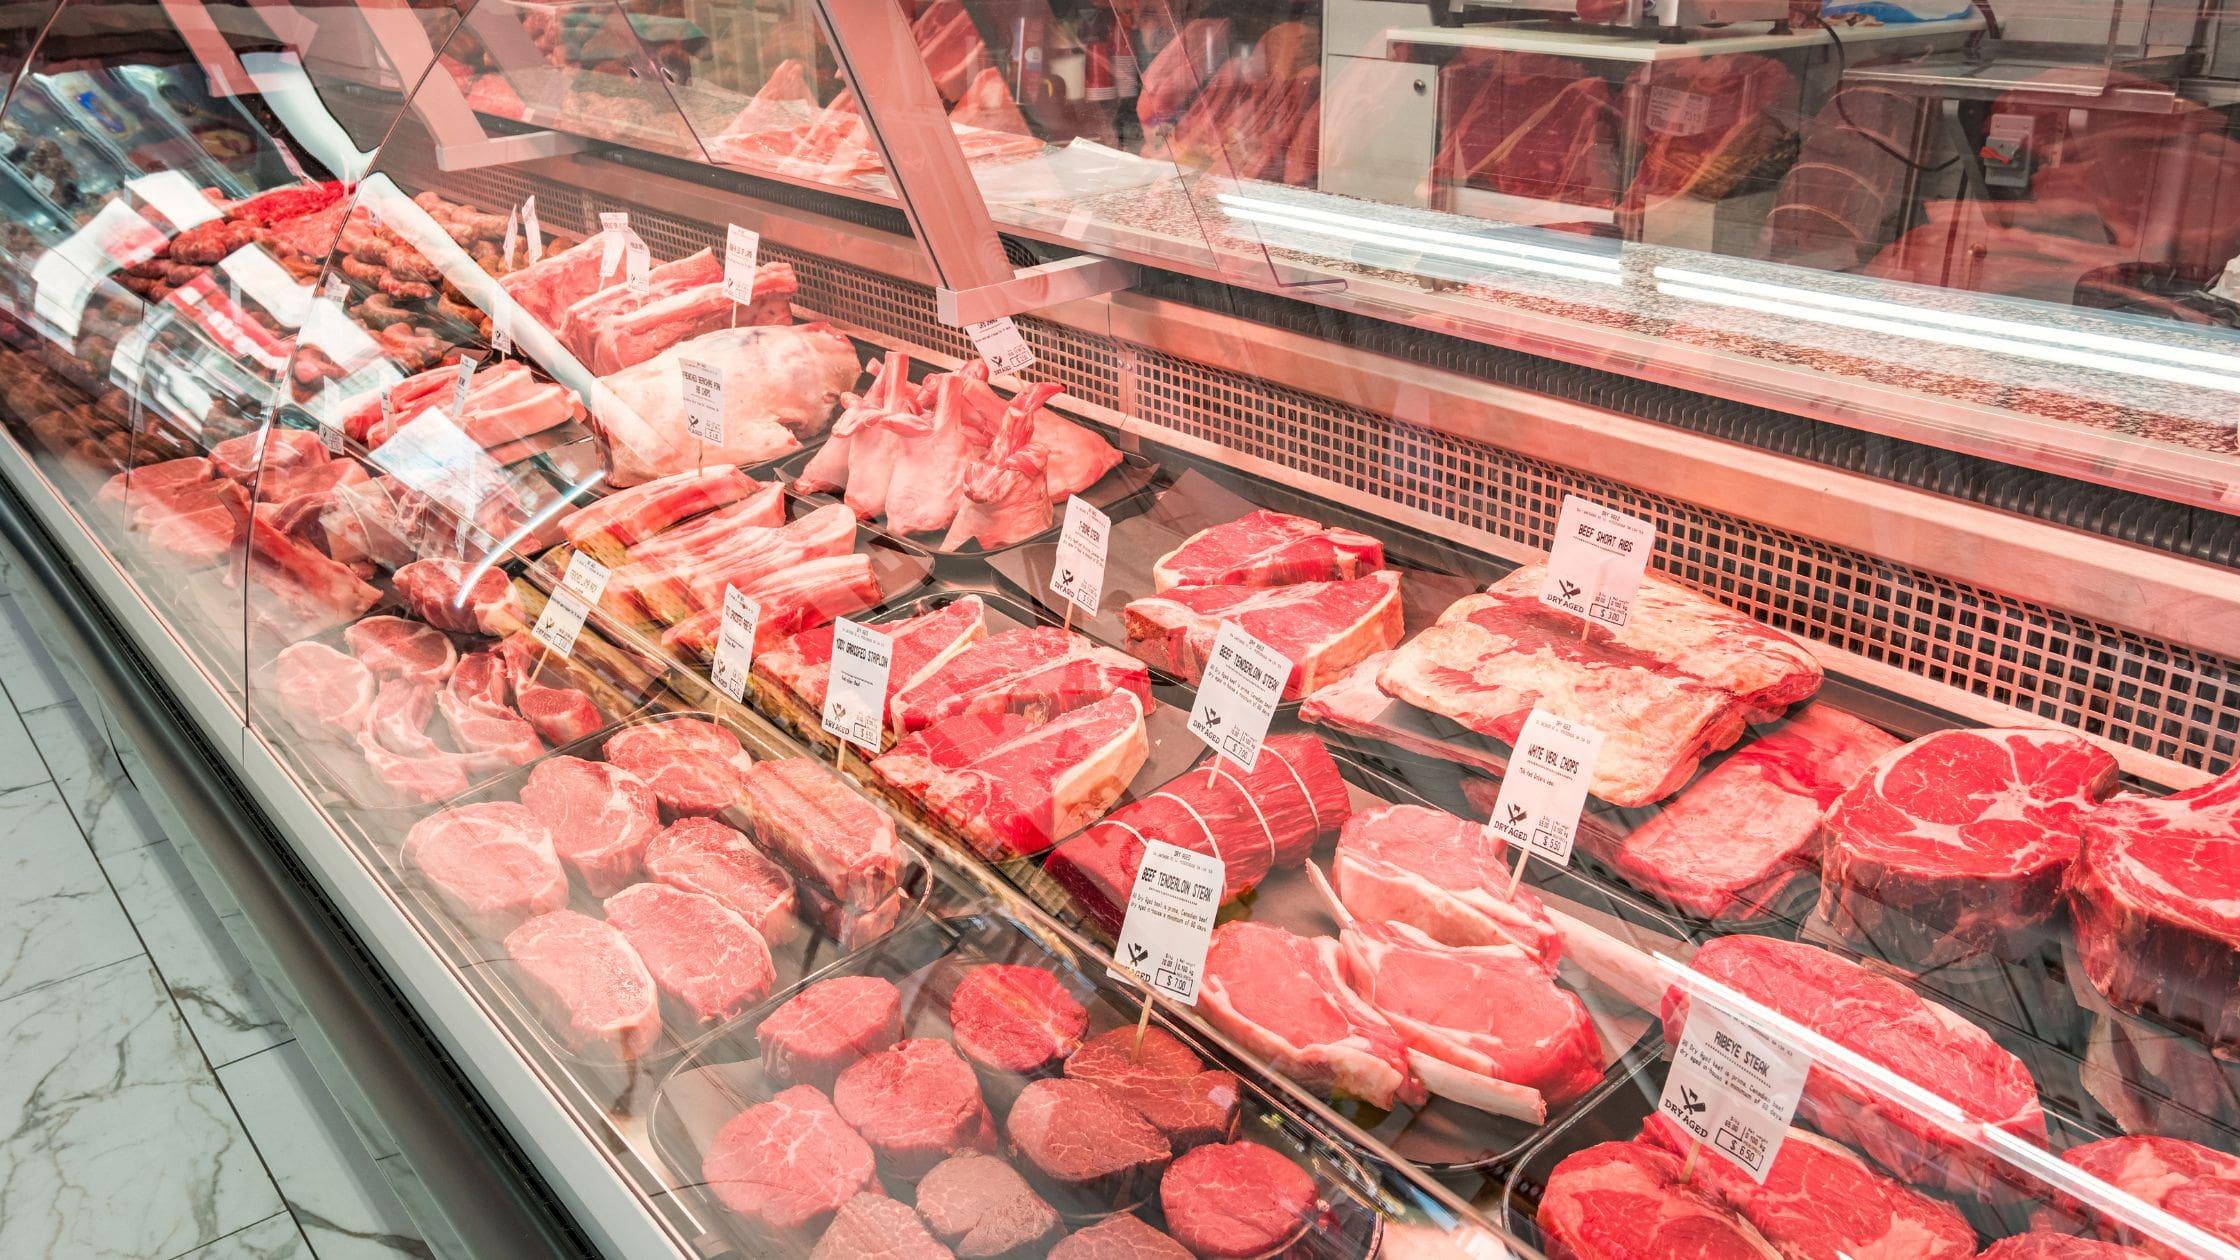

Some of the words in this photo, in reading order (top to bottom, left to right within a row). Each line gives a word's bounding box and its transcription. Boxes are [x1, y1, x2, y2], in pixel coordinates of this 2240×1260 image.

[1578, 523, 1595, 539] BEEF
[1596, 530, 1617, 547] SHORT
[1617, 538, 1634, 553] RIBS
[1546, 594, 1563, 605] DRY
[1562, 600, 1585, 613] AGED
[1600, 609, 1606, 617] $
[1219, 644, 1234, 662] BEEF
[1232, 653, 1263, 682] TENDERLOIN
[1262, 672, 1280, 693] STEAK
[1192, 719, 1206, 734] DRY
[1204, 728, 1221, 745] AGED
[1543, 750, 1560, 766] VEAL
[1559, 756, 1580, 775] CHOPS
[1494, 820, 1509, 834] DRY
[1508, 826, 1528, 842] AGED
[1141, 867, 1157, 884] BEEF
[1156, 872, 1192, 896] TENDERLOIN
[1192, 883, 1213, 902] STEAK
[1166, 975, 1173, 986] $
[1713, 1030, 1743, 1059] RIBEYE
[1742, 1049, 1772, 1077] STEAK
[1679, 1048, 1688, 1058] dry
[1690, 1055, 1702, 1067] aged
[1730, 1082, 1753, 1101] minimum
[1689, 1044, 1698, 1055] Dry
[1748, 1084, 1772, 1105] Canadian
[1664, 1098, 1684, 1119] DRY
[1682, 1113, 1709, 1140] AGED
[1729, 1138, 1738, 1152] $
[1739, 1145, 1756, 1163] 6.50
